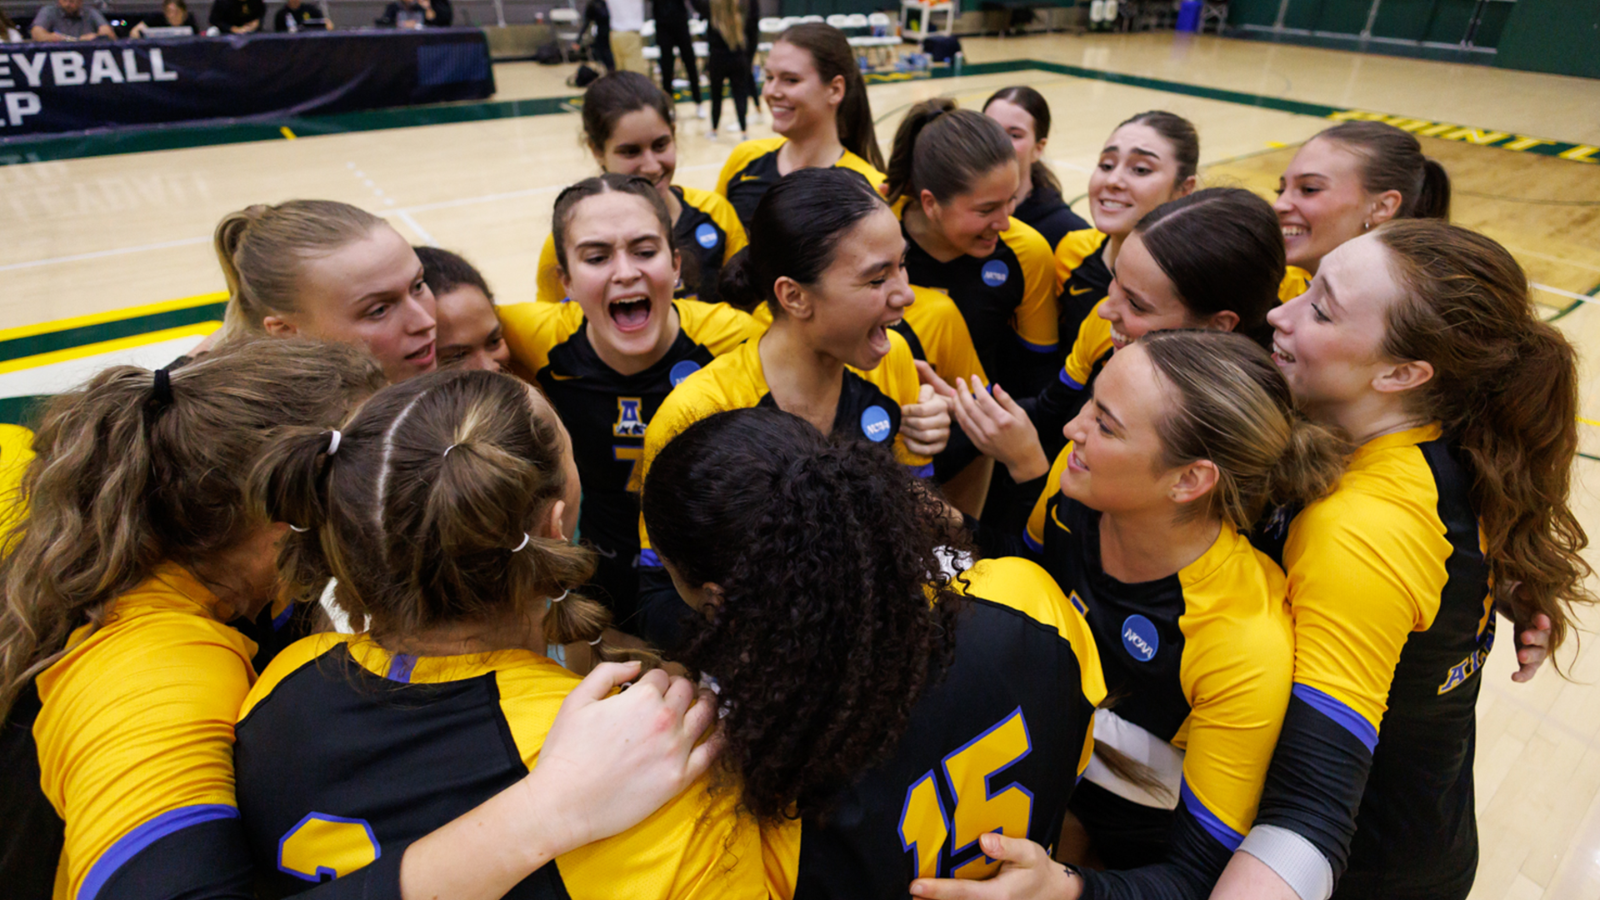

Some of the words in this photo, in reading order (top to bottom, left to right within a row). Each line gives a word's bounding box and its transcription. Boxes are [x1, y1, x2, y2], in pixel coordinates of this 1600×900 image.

[0, 91, 42, 127] P
[866, 419, 890, 435] NCAA
[612, 445, 645, 492] 7
[1123, 628, 1154, 659] NCAA
[897, 704, 1034, 879] 15
